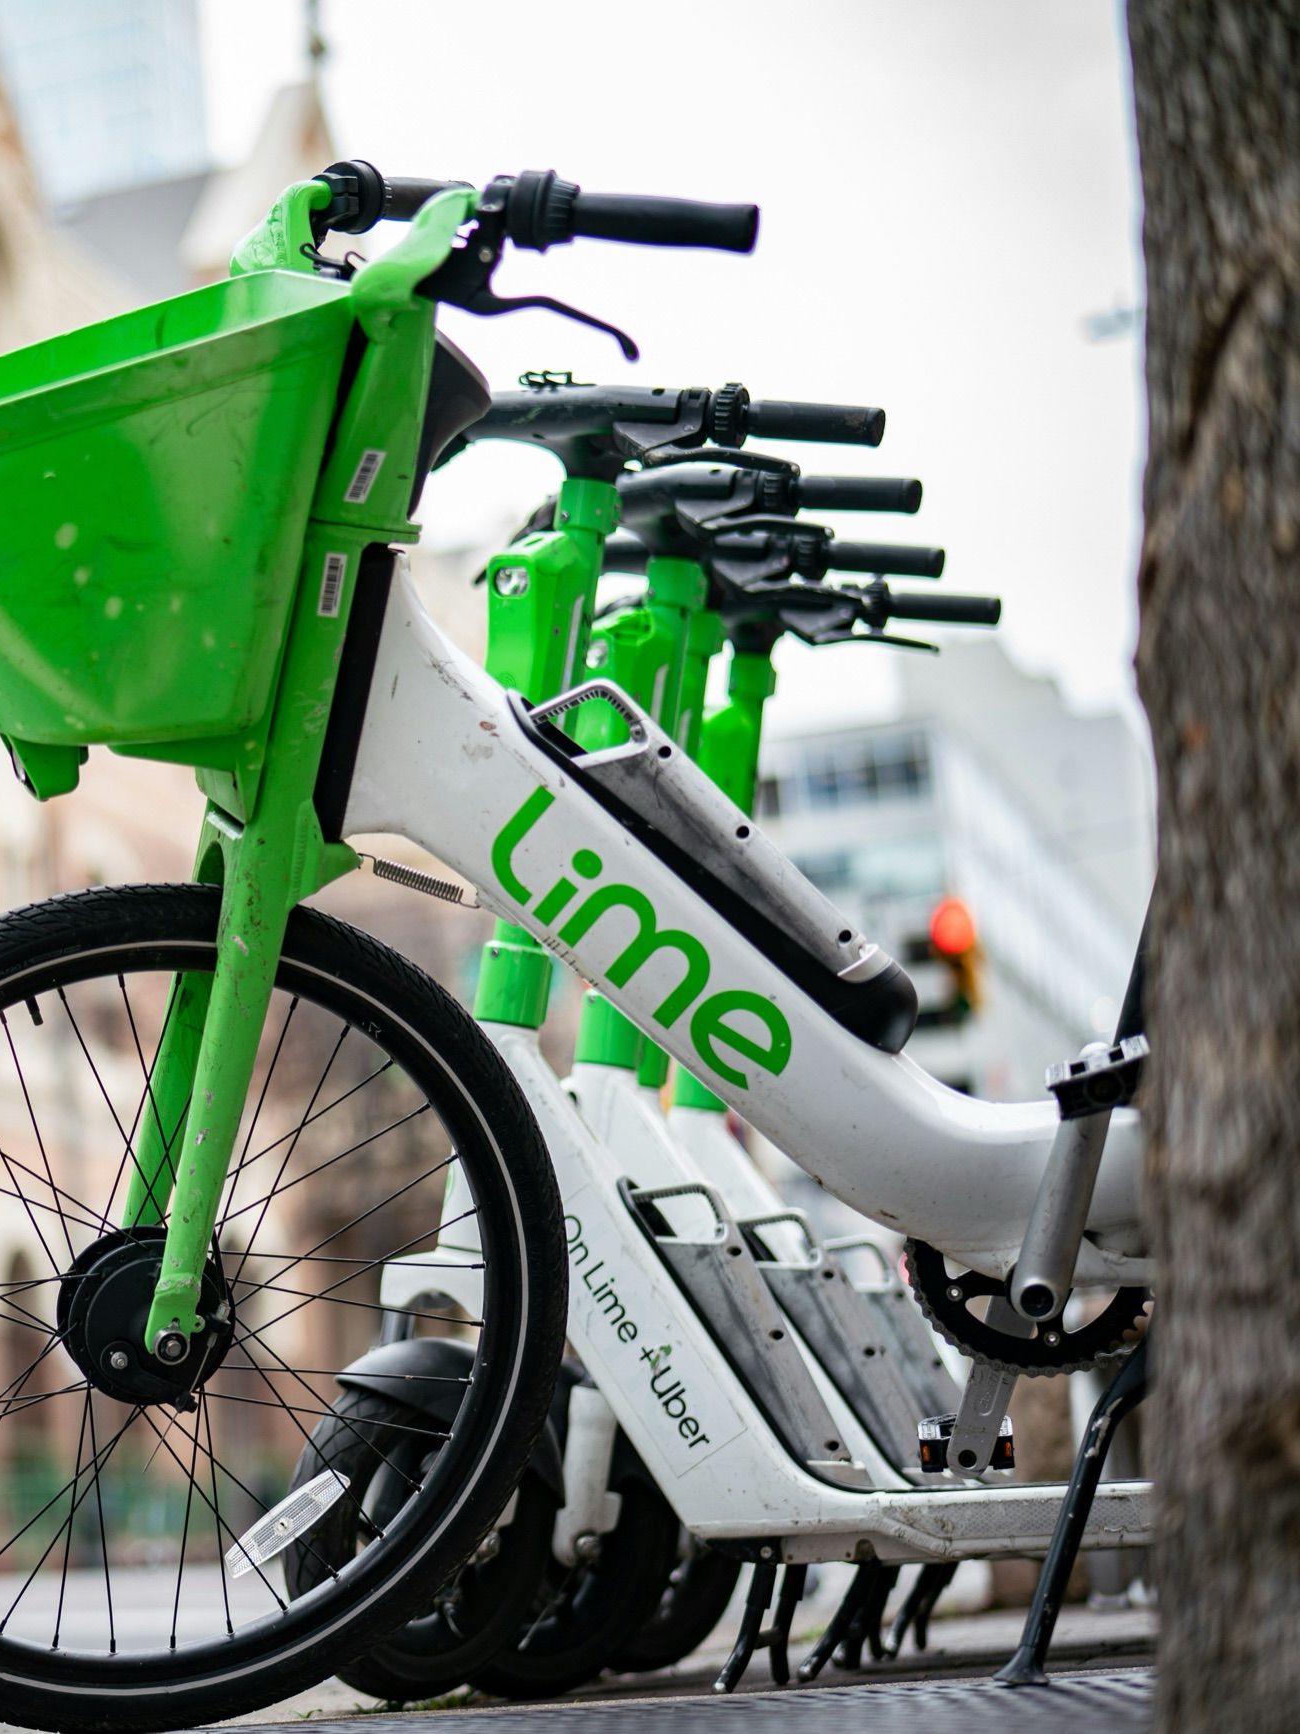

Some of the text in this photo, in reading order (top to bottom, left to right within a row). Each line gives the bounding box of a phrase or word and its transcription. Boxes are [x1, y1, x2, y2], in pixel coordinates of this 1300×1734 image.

[491, 786, 792, 1089] Lime
[564, 1214, 589, 1266] On
[582, 1261, 638, 1343] Lime
[650, 1365, 710, 1449] Uber
